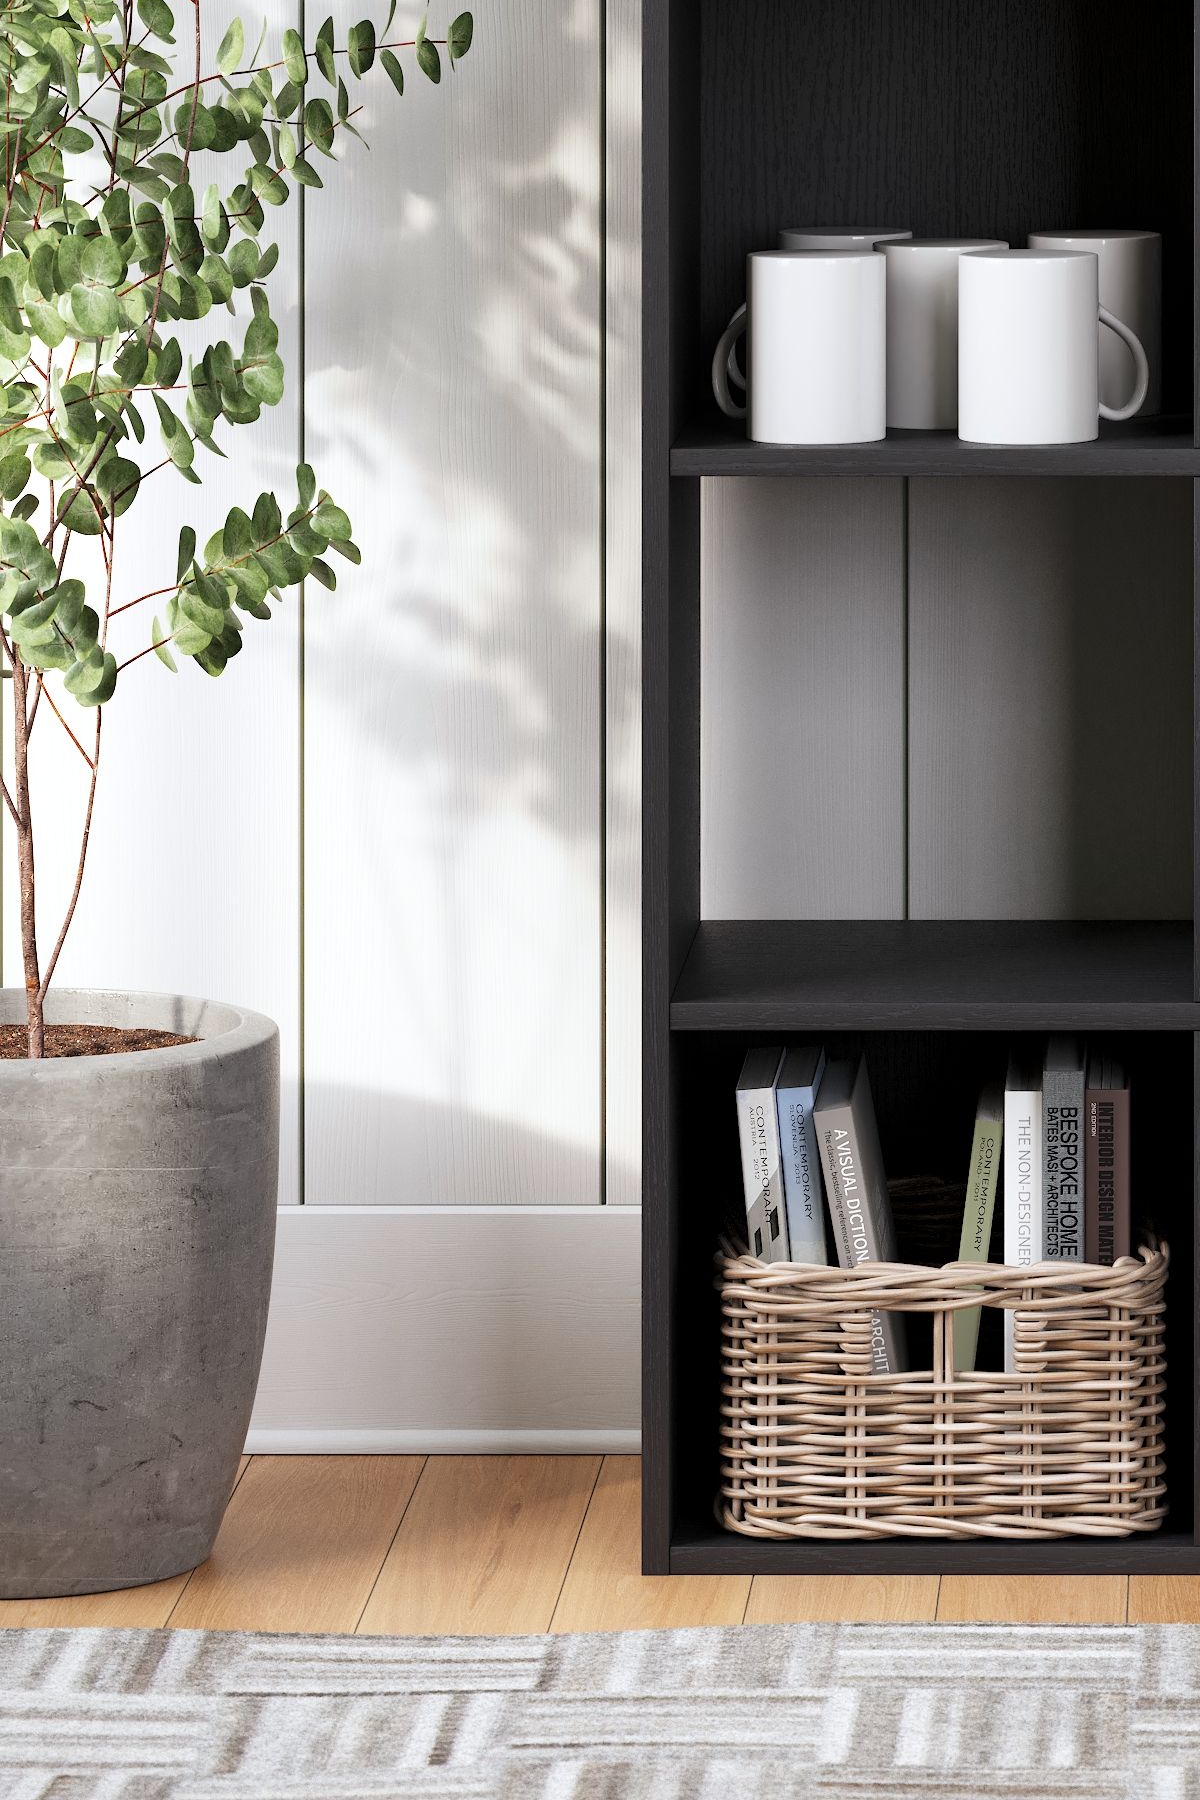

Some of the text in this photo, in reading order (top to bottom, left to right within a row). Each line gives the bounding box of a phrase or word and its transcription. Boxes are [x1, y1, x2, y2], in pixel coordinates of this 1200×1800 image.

[748, 1106, 761, 1180] AUSTRIA 2012
[755, 1105, 773, 1224] CONTEMPORARY
[796, 1103, 813, 1220] CONTEMPORARY
[834, 1129, 848, 1141] A
[837, 1141, 858, 1196] VISUAL
[1047, 1107, 1059, 1143] BATES
[824, 1130, 832, 1144] The
[831, 1171, 843, 1210] bestselling
[838, 1210, 850, 1244] reference
[844, 1244, 851, 1255] on
[974, 1138, 994, 1252] CONTEMPORARY
[1018, 1116, 1031, 1266] THE NON-DESIGNER
[1047, 1184, 1059, 1256] ARCHITECTS
[1060, 1107, 1078, 1257] BESPOKE HOME
[1098, 1102, 1114, 1264] INTERIOR DESIGN MATE
[846, 1198, 870, 1264] DICTION
[871, 1318, 890, 1375] ARCHIT
